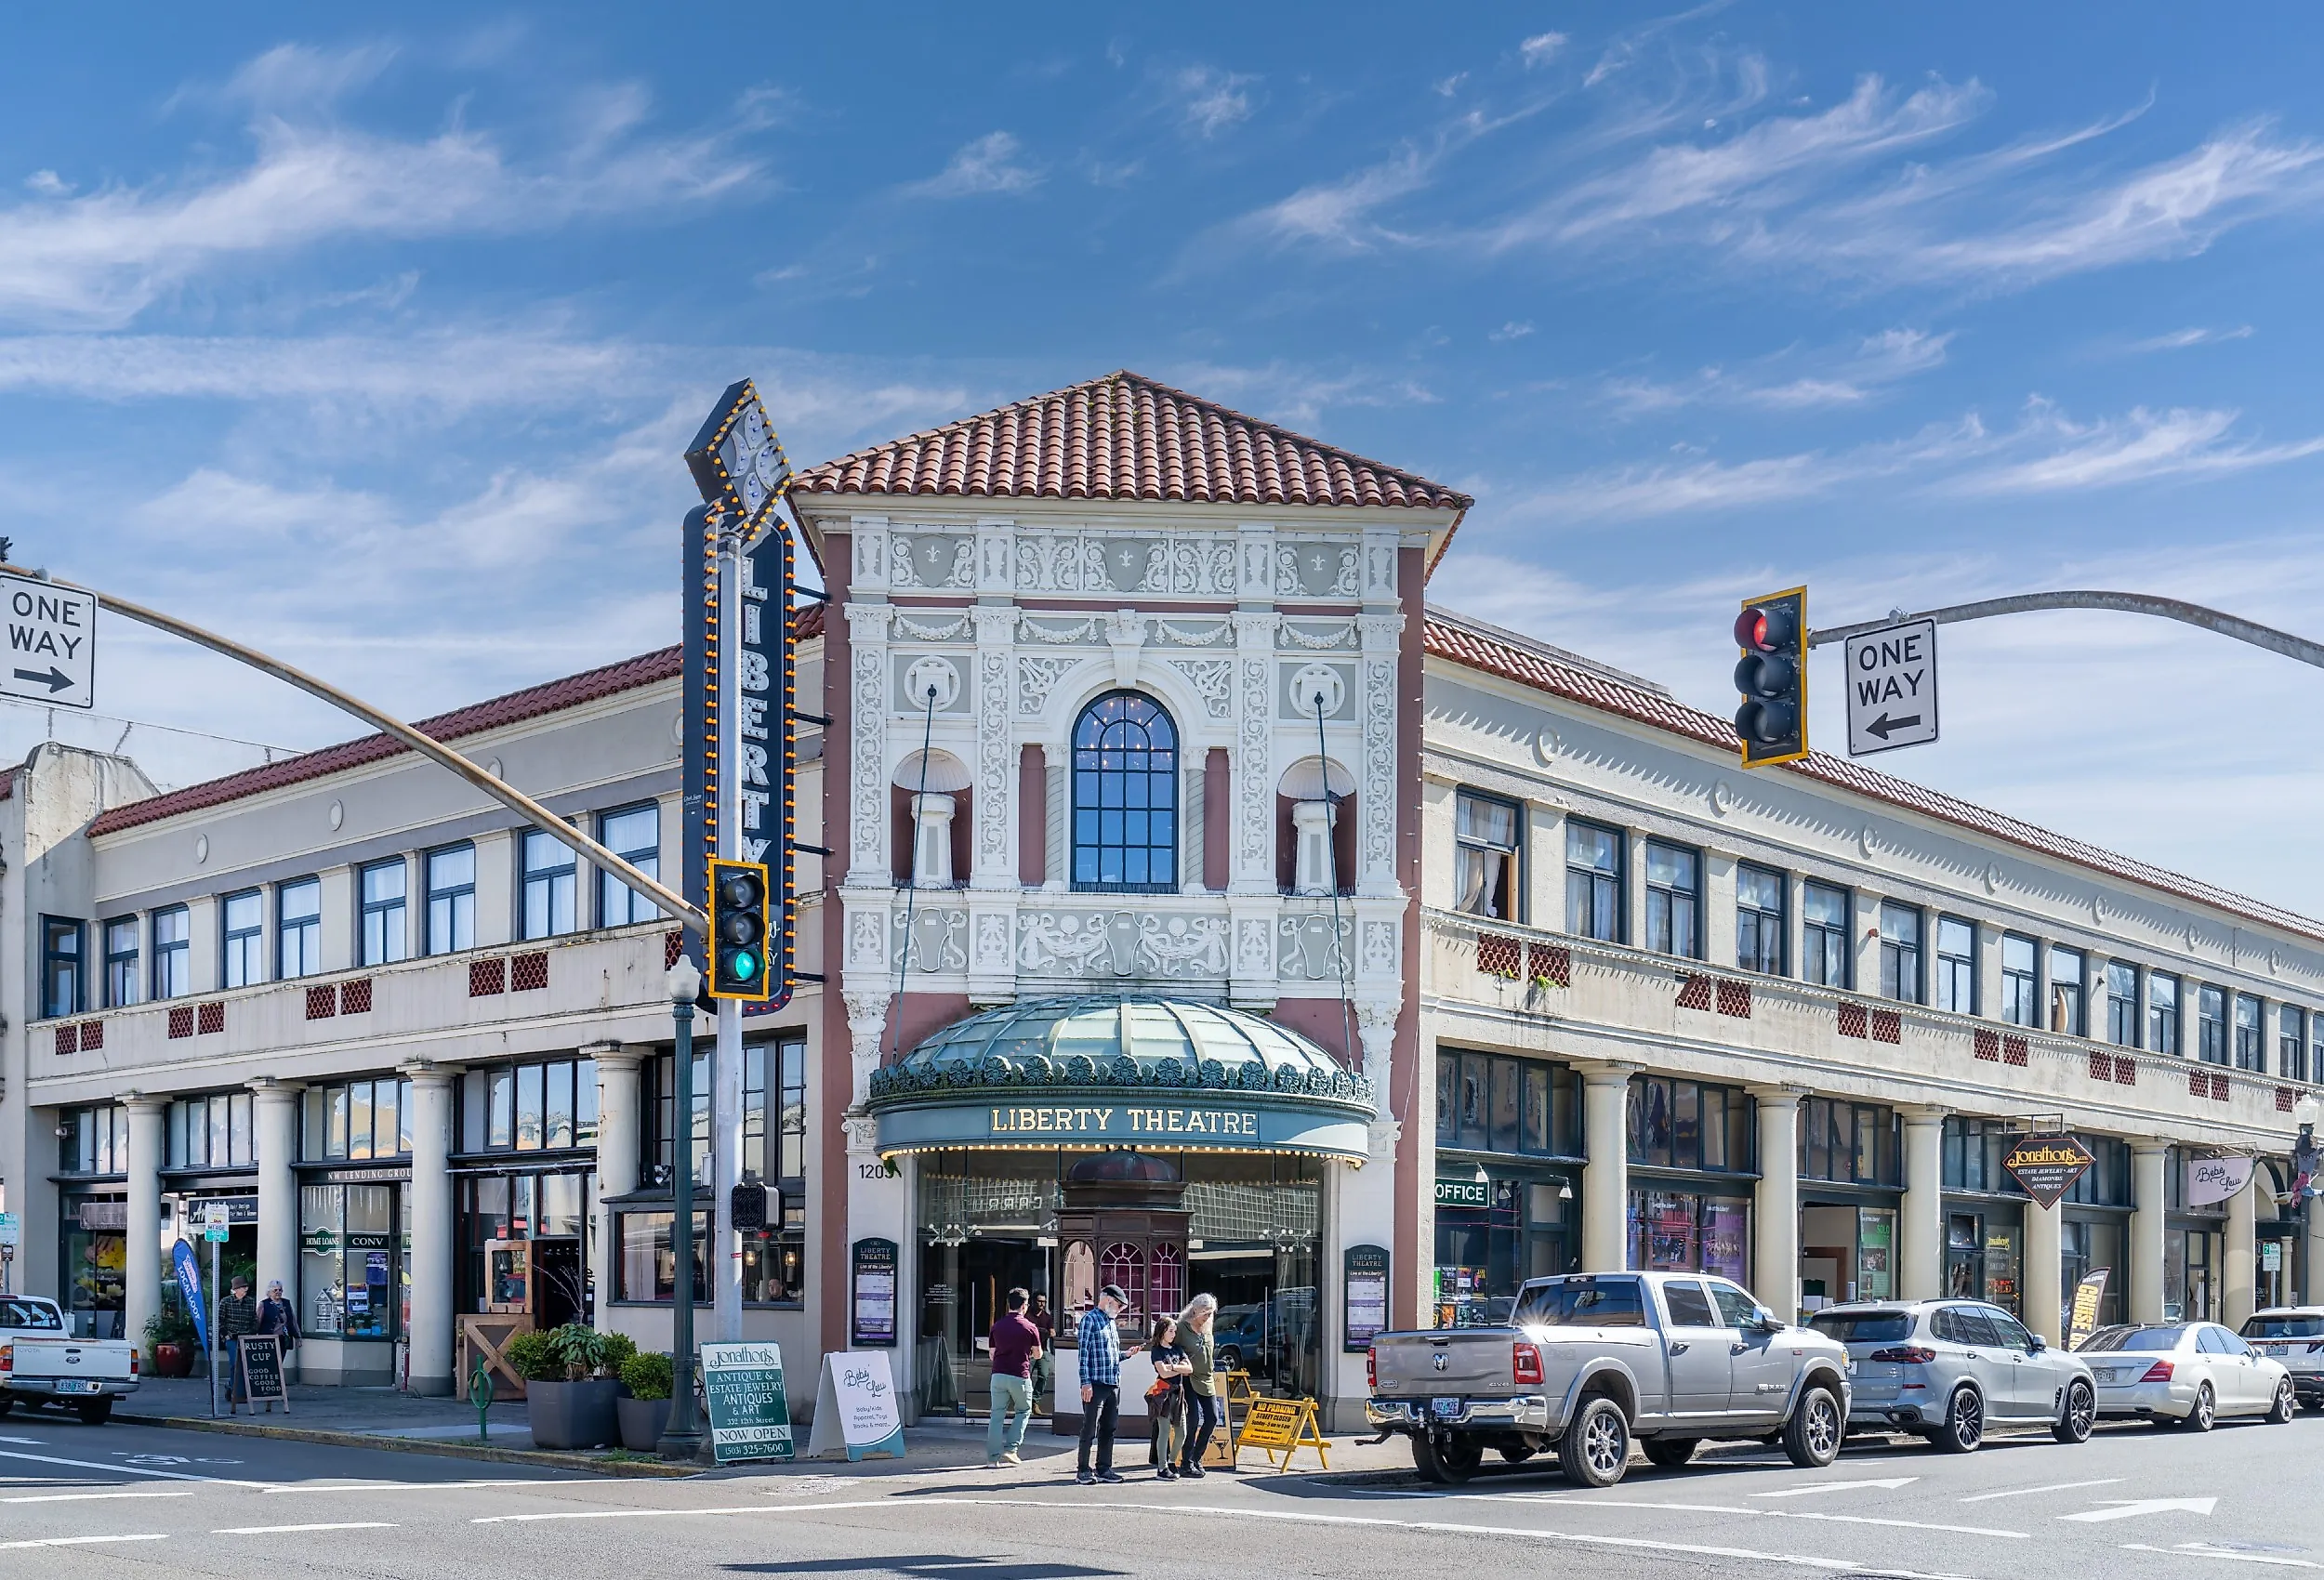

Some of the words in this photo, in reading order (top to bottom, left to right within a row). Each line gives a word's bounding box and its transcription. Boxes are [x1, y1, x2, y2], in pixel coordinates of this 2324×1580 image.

[12, 591, 81, 628] ONE
[8, 624, 83, 660] WAY
[1859, 634, 1922, 671] ONE
[1857, 669, 1925, 707] WAY
[741, 556, 772, 862] LIBERTY
[991, 1108, 1114, 1132] LIBERTY
[1127, 1109, 1257, 1135] THEATRE
[327, 1172, 340, 1180] NW
[345, 1170, 384, 1179] LENDING
[388, 1168, 411, 1178] GROU
[1434, 1183, 1485, 1202] OFFICE
[306, 1237, 322, 1245] HOME
[323, 1237, 339, 1245] LOANS
[351, 1238, 383, 1246] CONV
[2265, 1245, 2269, 1254] 2
[178, 1266, 191, 1296] LOCAL
[2071, 1284, 2098, 1331] CRUISE
[244, 1342, 275, 1350] RUSTY
[251, 1352, 271, 1362] CUP
[709, 1346, 774, 1369] Jonathon's
[717, 1372, 763, 1383] ANTIQUE
[765, 1371, 774, 1380] &
[710, 1384, 742, 1394] ESTATE
[744, 1381, 783, 1393] JEWELRY
[723, 1392, 773, 1405] ANTIQUES
[733, 1407, 739, 1415] &
[742, 1404, 760, 1415] ART
[1256, 1402, 1267, 1411] NO
[1267, 1403, 1296, 1415] PARKING
[720, 1429, 748, 1442] NOW
[754, 1427, 786, 1440] OPEN
[725, 1446, 742, 1455] (503)
[743, 1442, 785, 1455] 325-7600
